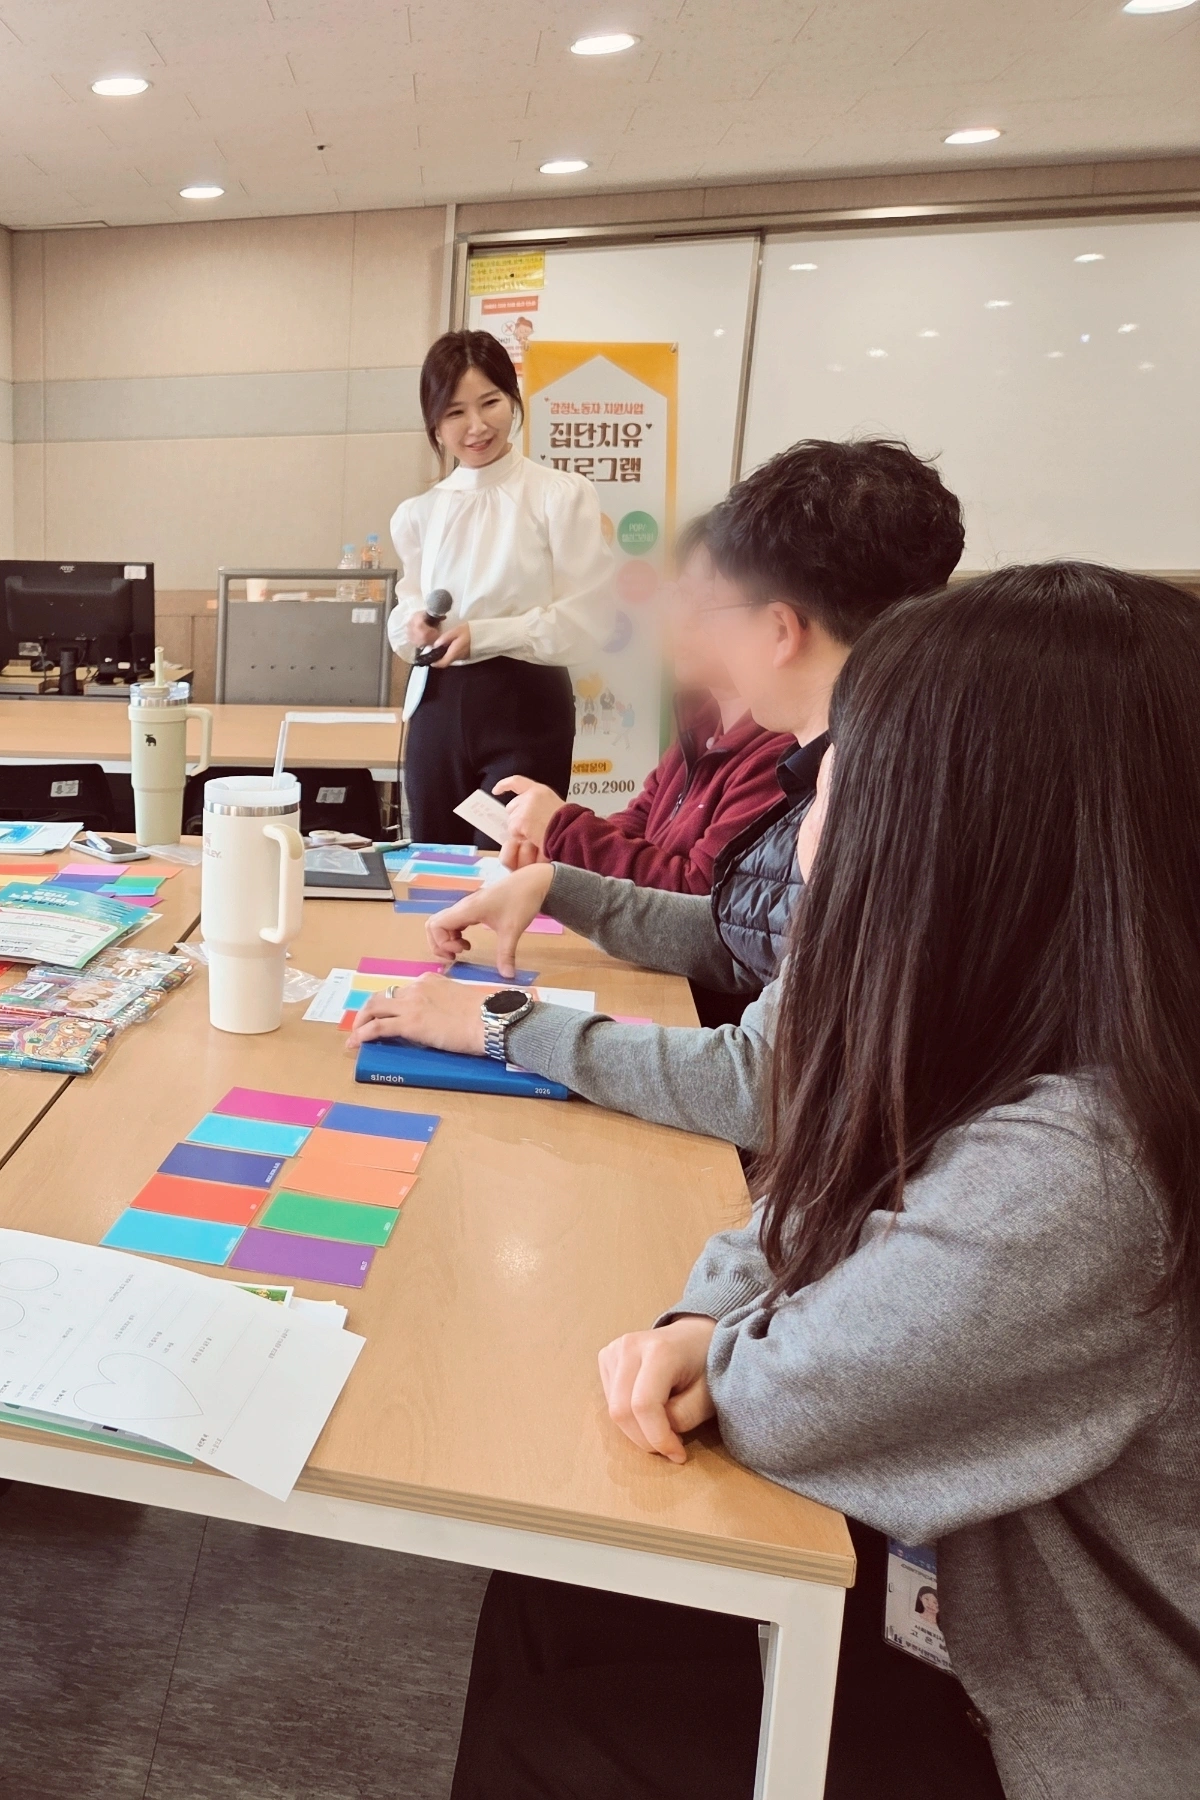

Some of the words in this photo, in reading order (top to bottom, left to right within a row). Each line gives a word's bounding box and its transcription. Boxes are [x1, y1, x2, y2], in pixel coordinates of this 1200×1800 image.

[550, 402, 600, 415] 감정노동자
[603, 403, 644, 415] 지원사업
[549, 422, 643, 448] 집단치유
[370, 1073, 404, 1083] sindoh
